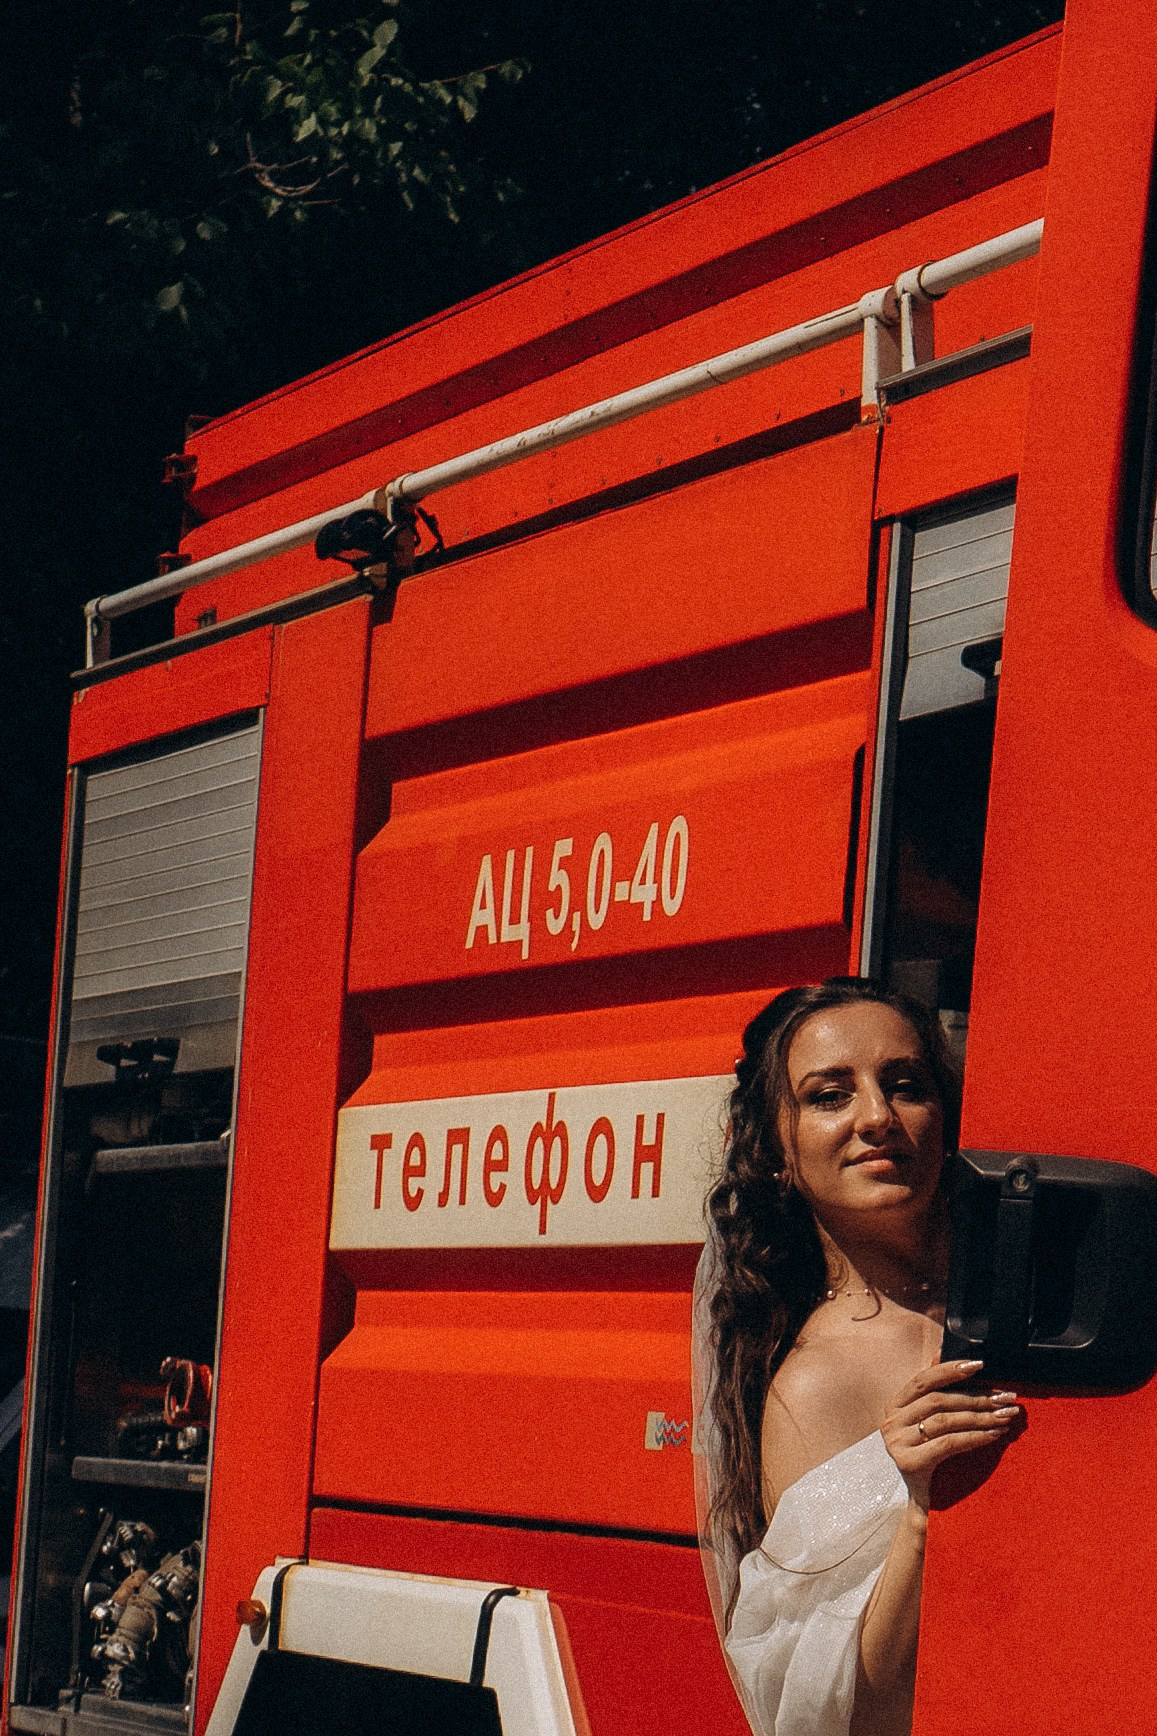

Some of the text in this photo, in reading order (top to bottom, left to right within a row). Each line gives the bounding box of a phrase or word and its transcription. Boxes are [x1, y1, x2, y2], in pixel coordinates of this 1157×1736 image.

[465, 814, 690, 960] АЦ 5,0-40
[369, 1091, 666, 1236] телефон
